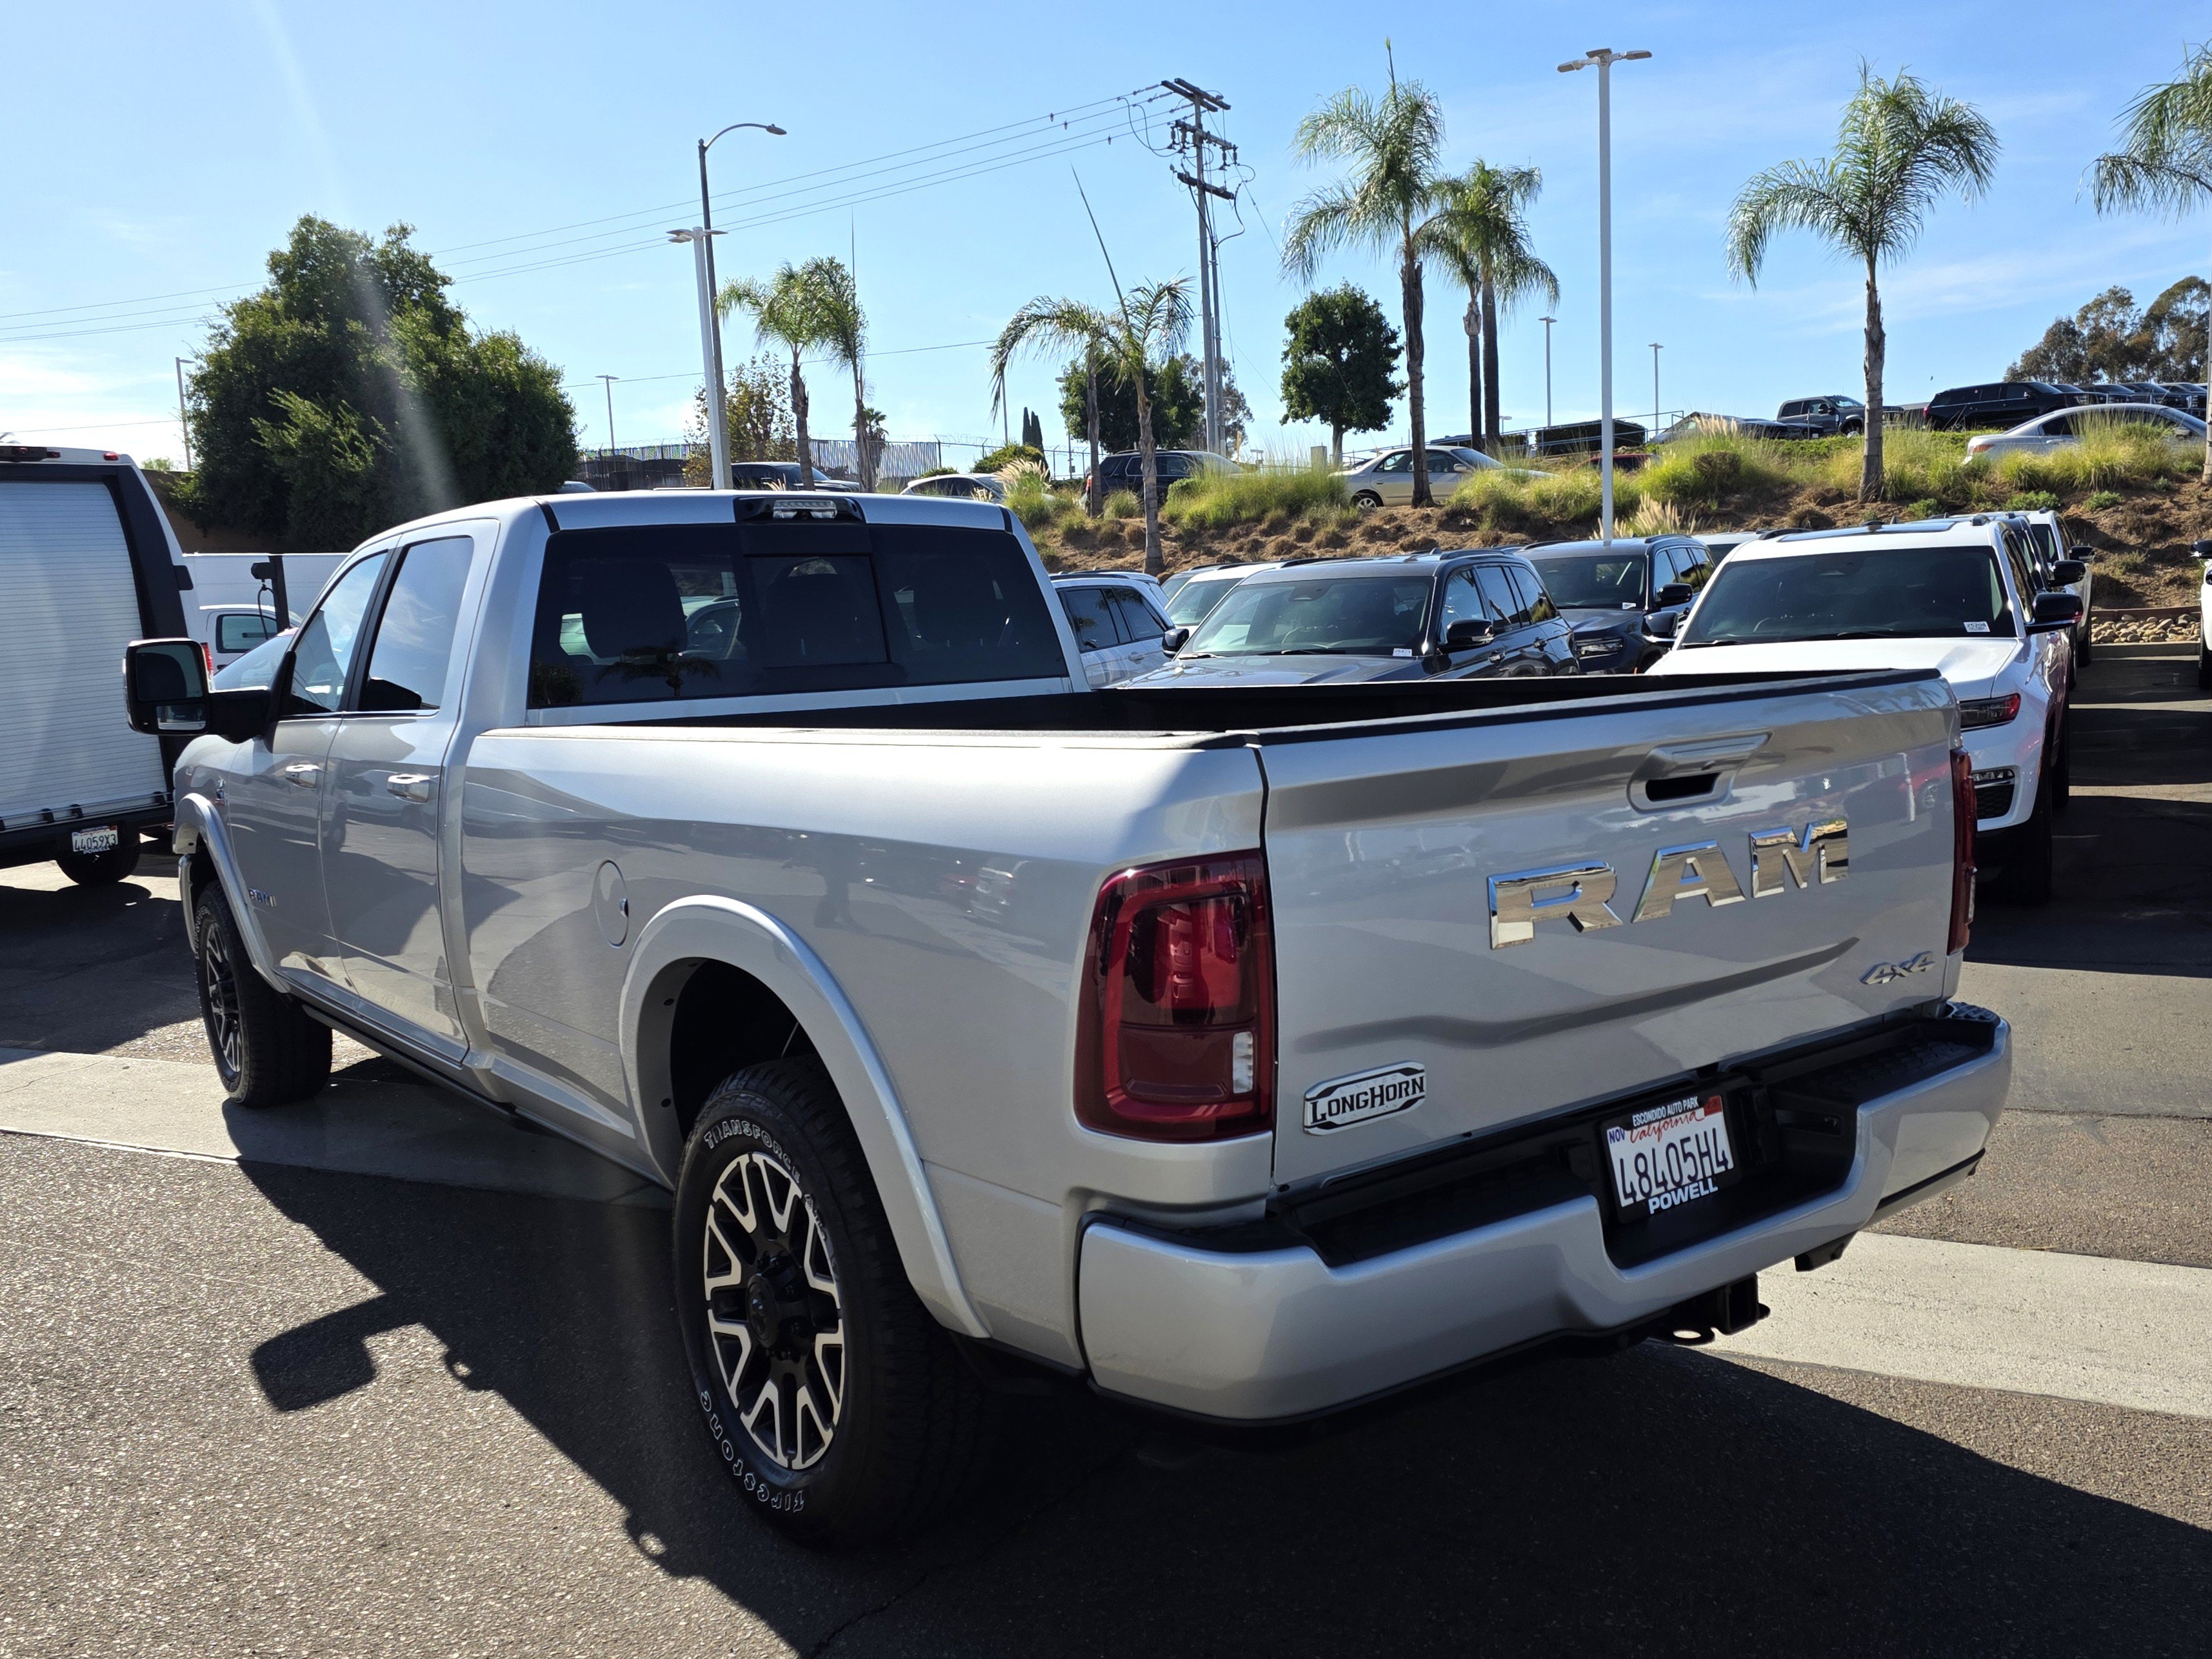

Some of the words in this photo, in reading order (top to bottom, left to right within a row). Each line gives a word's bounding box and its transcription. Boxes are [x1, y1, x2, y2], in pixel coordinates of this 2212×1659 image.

[75, 834, 116, 850] 44059X3
[1488, 816, 1849, 950] RAM
[1629, 1111, 1705, 1144] California
[1632, 1106, 1666, 1127] ESCONDIDO
[1667, 1100, 1683, 1116] AUTO
[1683, 1096, 1699, 1110] PARK
[704, 1120, 801, 1184] TRANSFORCE
[1609, 1129, 1625, 1144] NOV
[1620, 1128, 1728, 1198] 48405H4
[1648, 1178, 1718, 1214] POWELL
